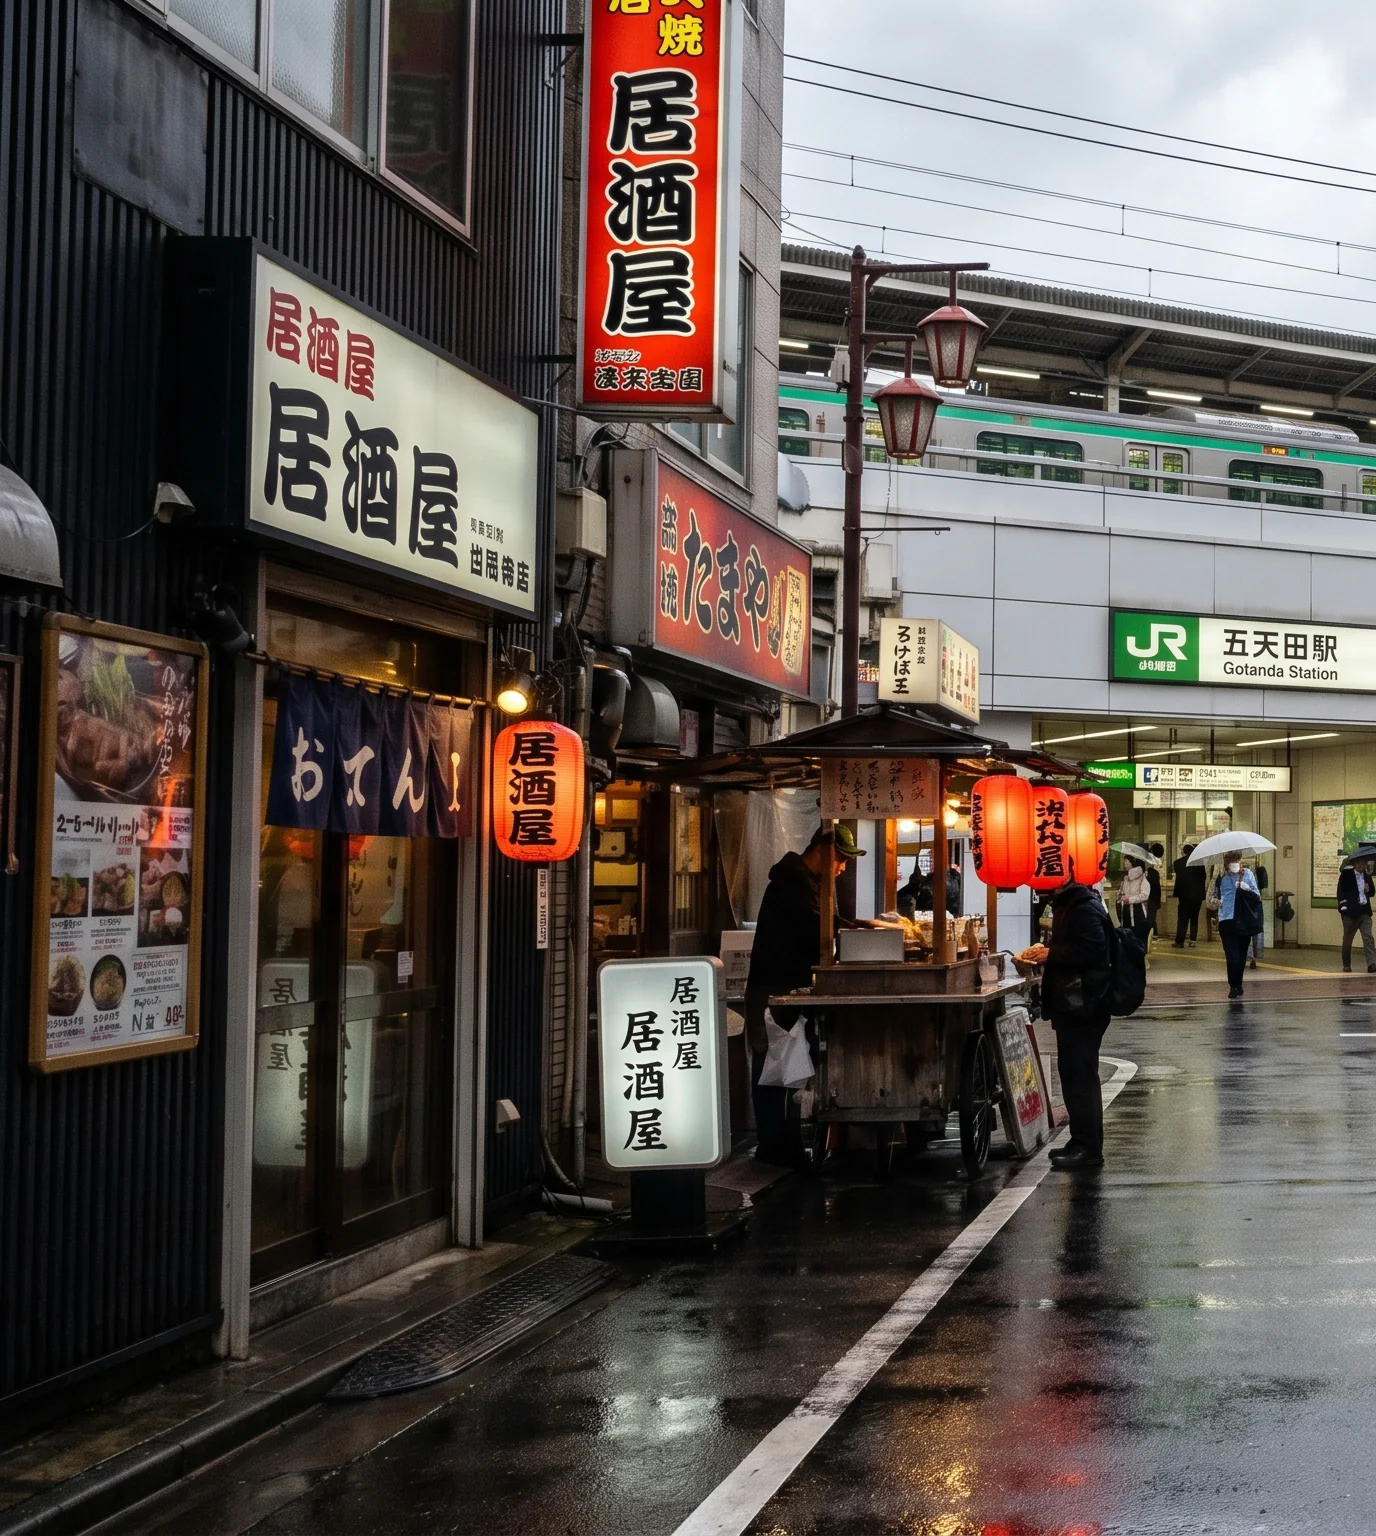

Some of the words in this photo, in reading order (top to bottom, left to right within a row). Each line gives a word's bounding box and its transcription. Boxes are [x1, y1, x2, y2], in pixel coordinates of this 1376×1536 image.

[658, 0, 704, 56] 焼
[603, 68, 698, 336] 居酒屋
[267, 286, 375, 401] 居酒屋
[264, 381, 459, 569] 居酒屋
[683, 508, 770, 652] たまや
[1127, 623, 1188, 660] JR
[1223, 629, 1338, 663] 五天田駅
[1223, 661, 1285, 678] Gotanda
[1288, 664, 1338, 682] Station
[508, 731, 559, 847] 居酒屋
[621, 1010, 668, 1151] 居酒屋
[670, 976, 702, 1070] 居酒屋
